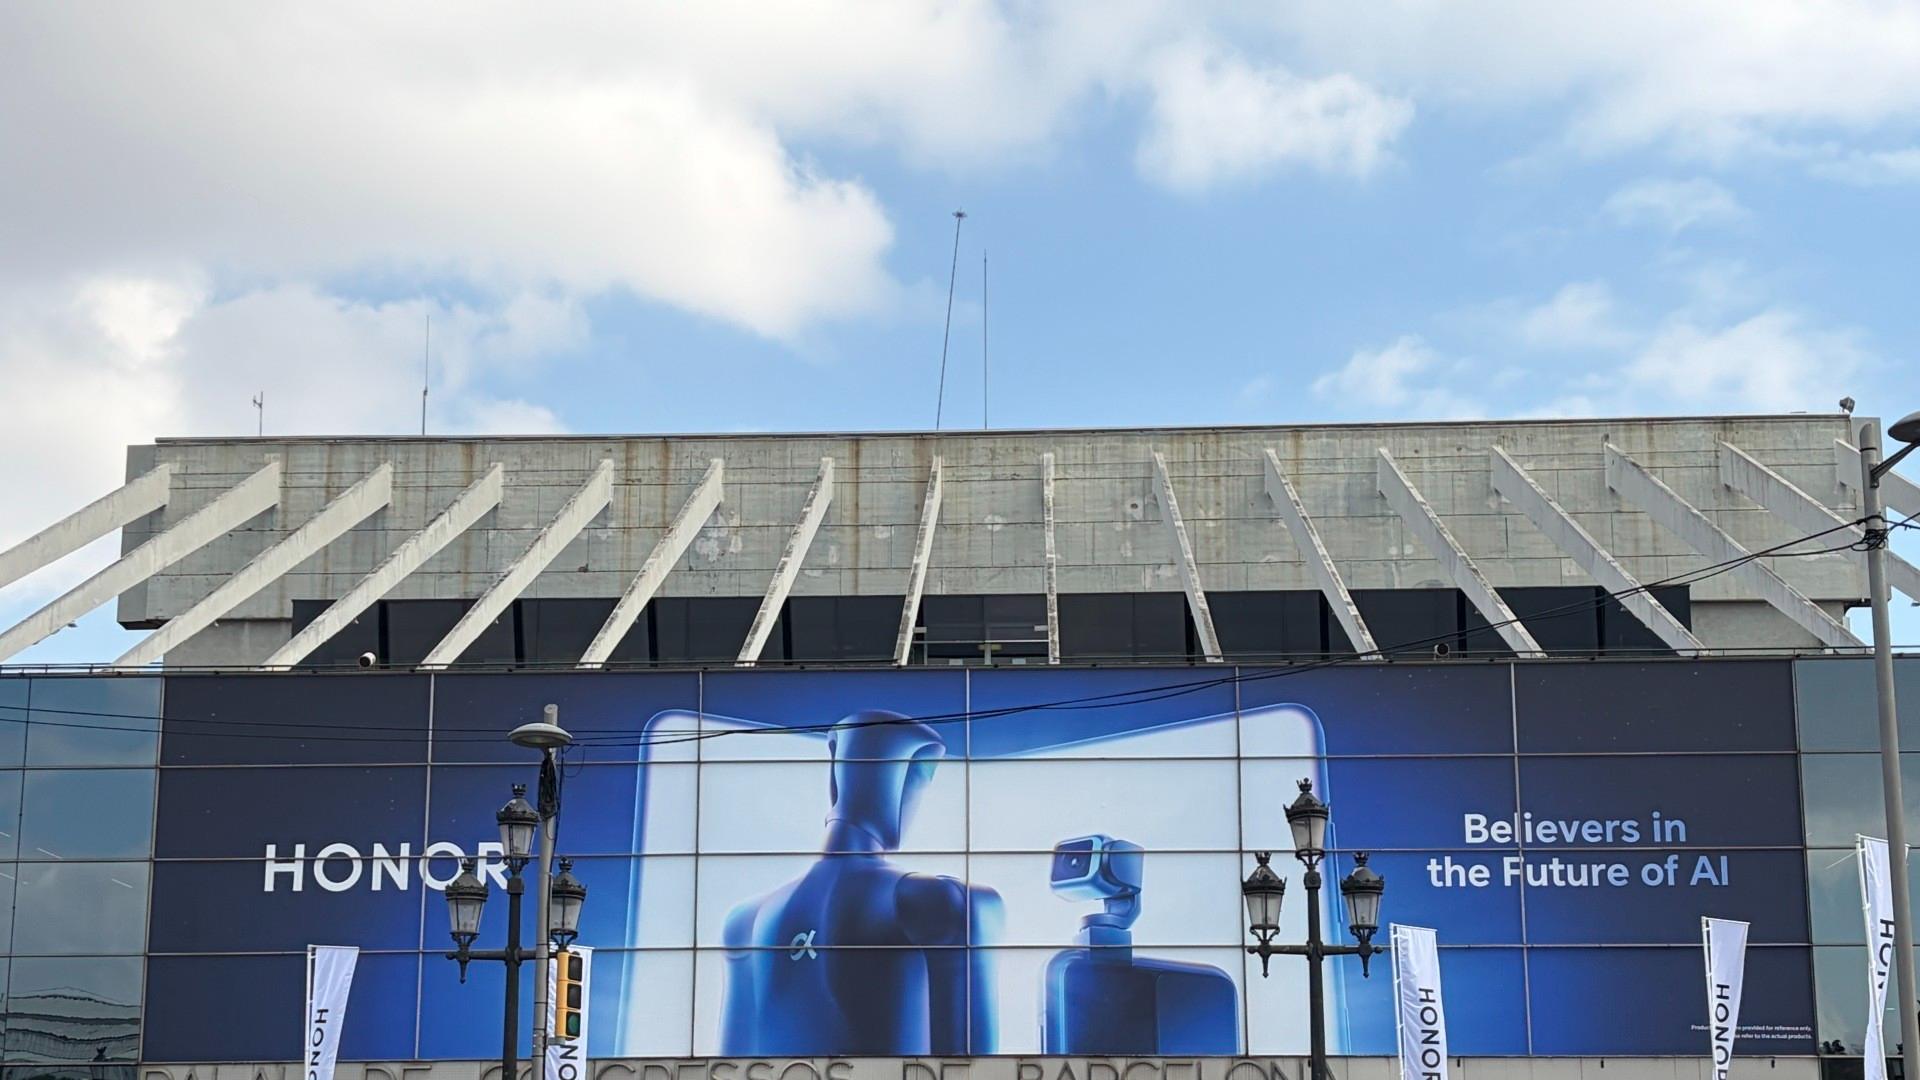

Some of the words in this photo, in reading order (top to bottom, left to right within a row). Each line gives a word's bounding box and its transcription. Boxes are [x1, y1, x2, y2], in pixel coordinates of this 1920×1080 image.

[1464, 811, 1640, 843] Believers
[1653, 811, 1686, 843] in
[264, 842, 508, 892] HONOR
[1427, 856, 1490, 887] the
[1503, 856, 1629, 887] Future
[1641, 854, 1678, 887] of
[1690, 855, 1729, 886] AI
